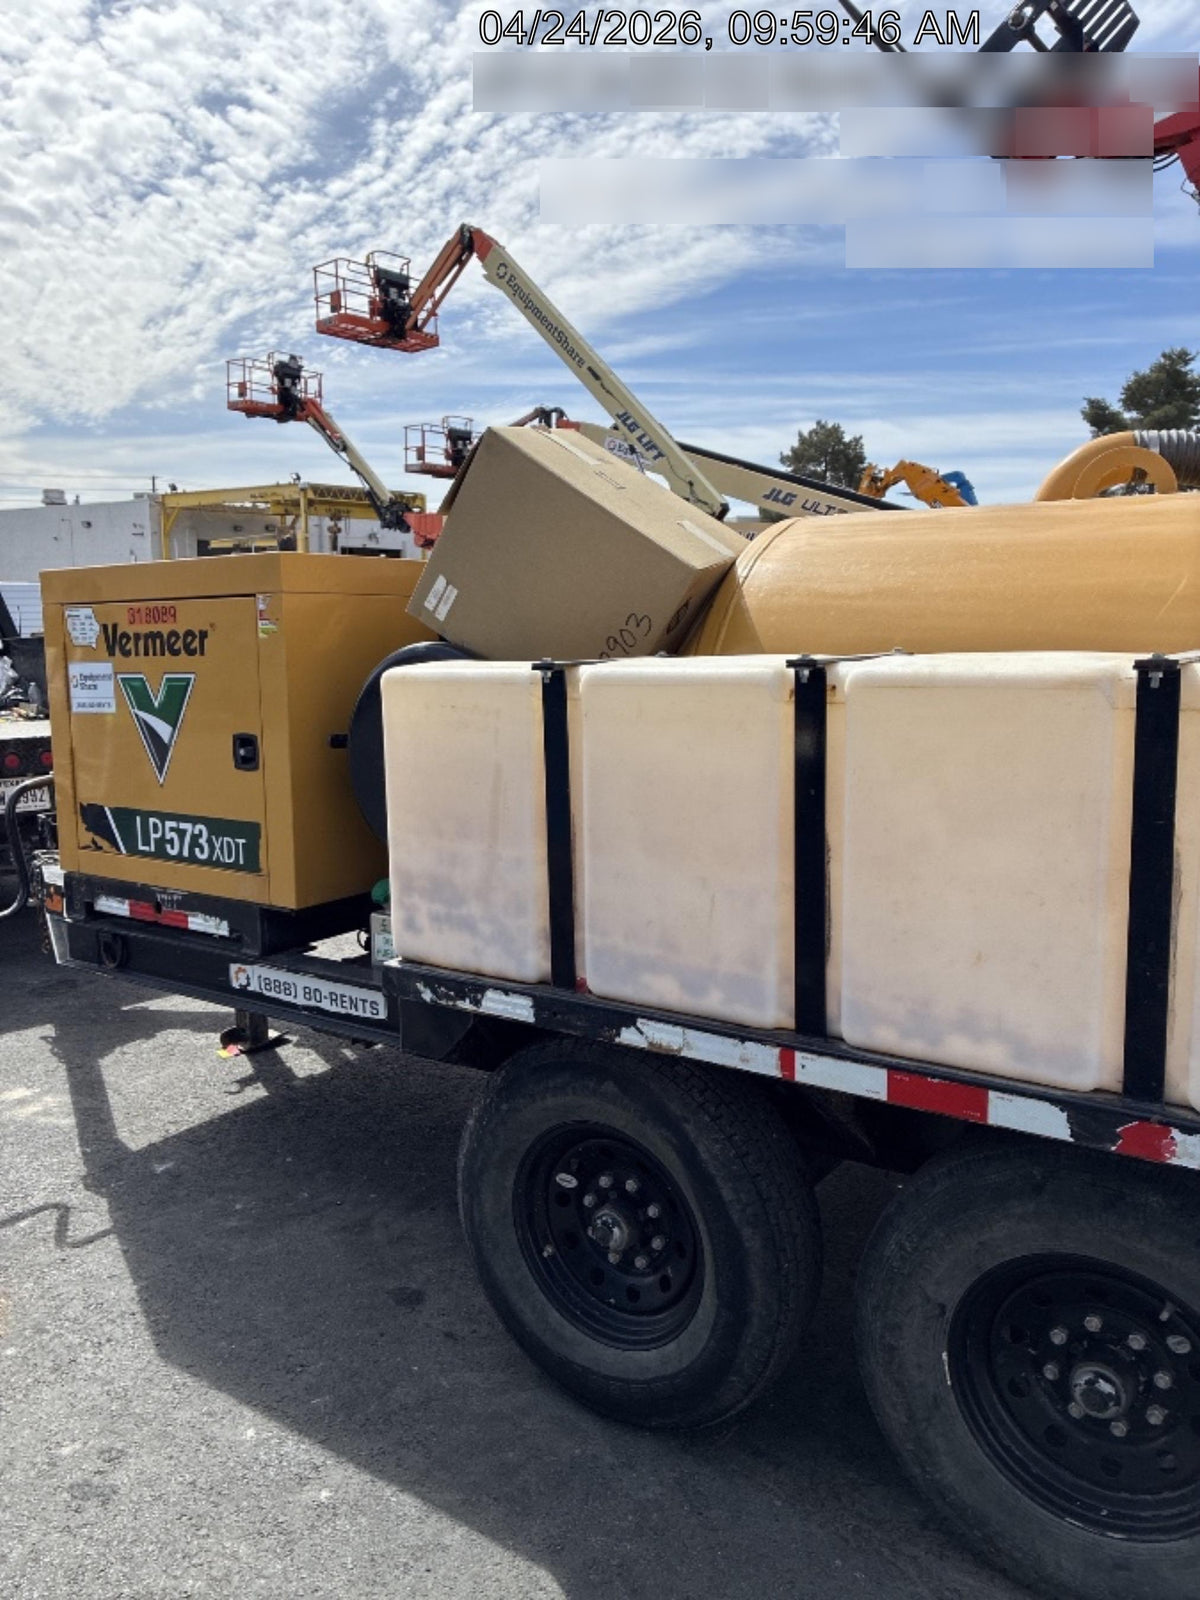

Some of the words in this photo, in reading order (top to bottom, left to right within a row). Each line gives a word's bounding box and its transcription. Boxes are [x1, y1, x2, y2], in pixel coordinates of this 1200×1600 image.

[506, 274, 586, 369] EquipmentShare
[615, 411, 640, 434] JLG
[636, 432, 666, 461] LIFT
[762, 486, 798, 507] JLG
[102, 622, 209, 658] Vermeer
[257, 974, 298, 999] (888)
[302, 985, 381, 1016] 80-RENTS
